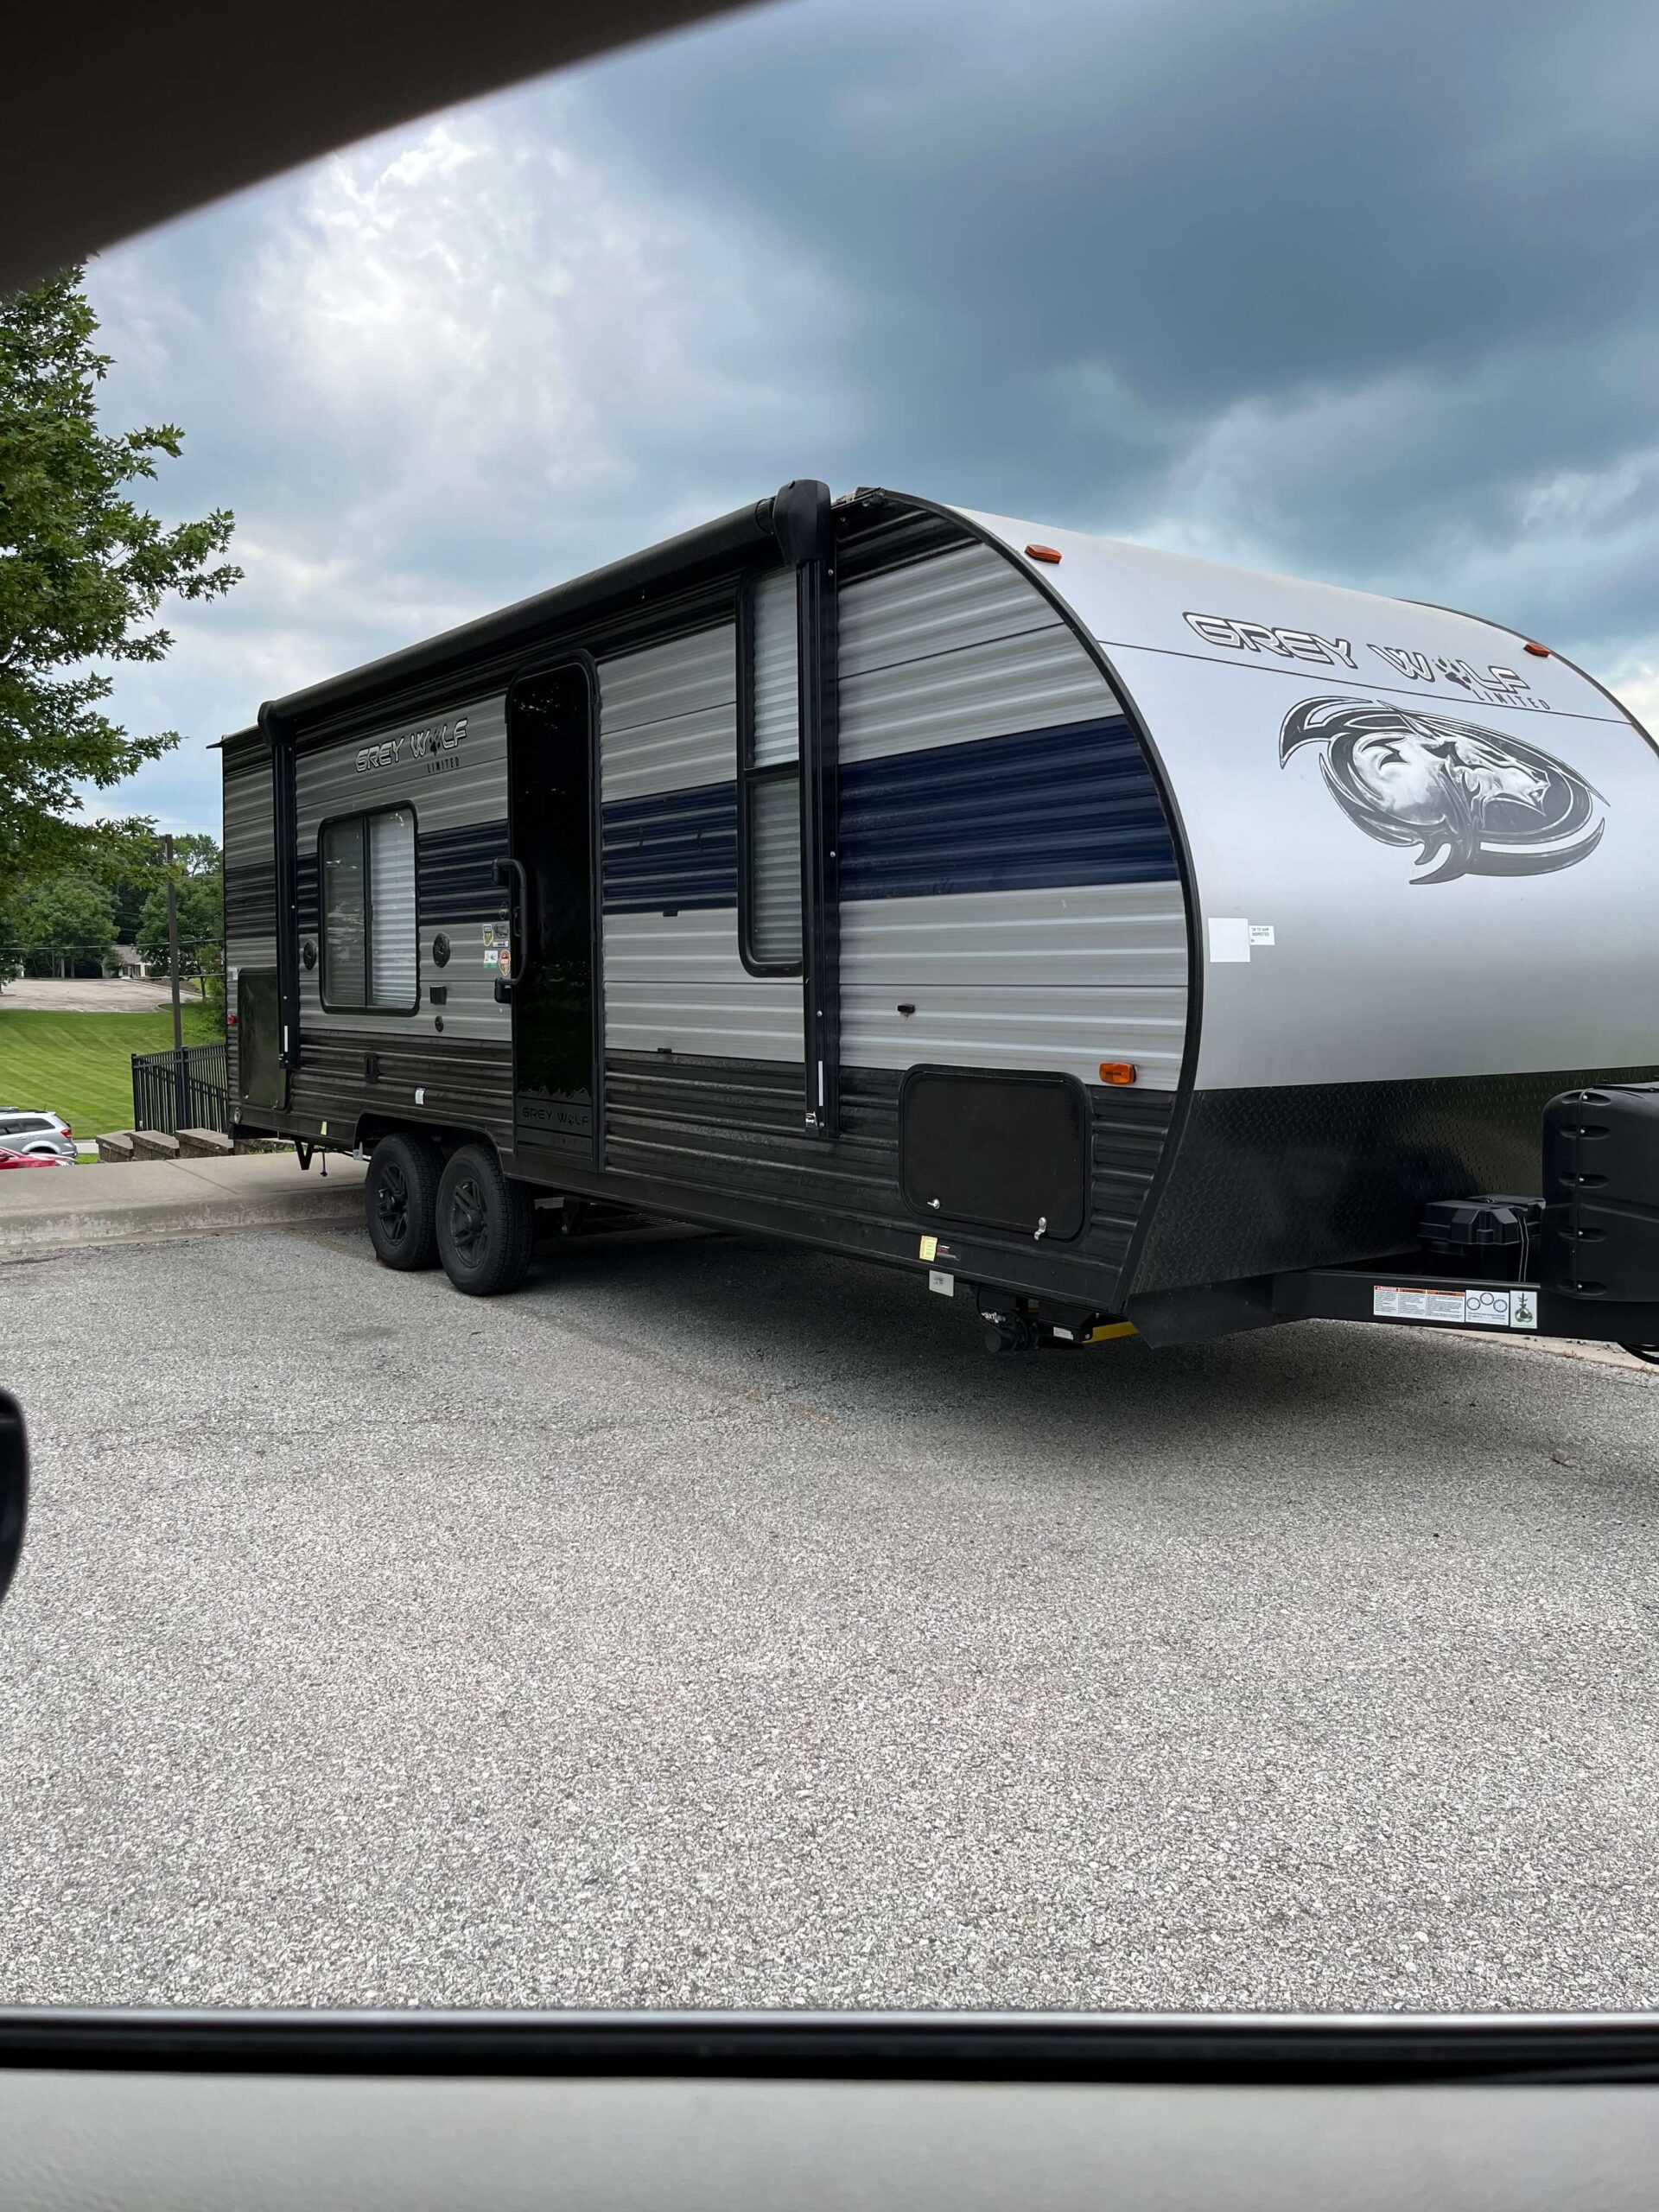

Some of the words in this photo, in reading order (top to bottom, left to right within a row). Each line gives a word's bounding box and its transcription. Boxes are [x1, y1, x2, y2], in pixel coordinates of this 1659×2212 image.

[1182, 612, 1358, 669] GREY
[1472, 689, 1551, 710] LIMITED
[356, 735, 404, 772] GREY
[427, 756, 460, 773] LIMITED
[522, 1107, 552, 1121] GREY
